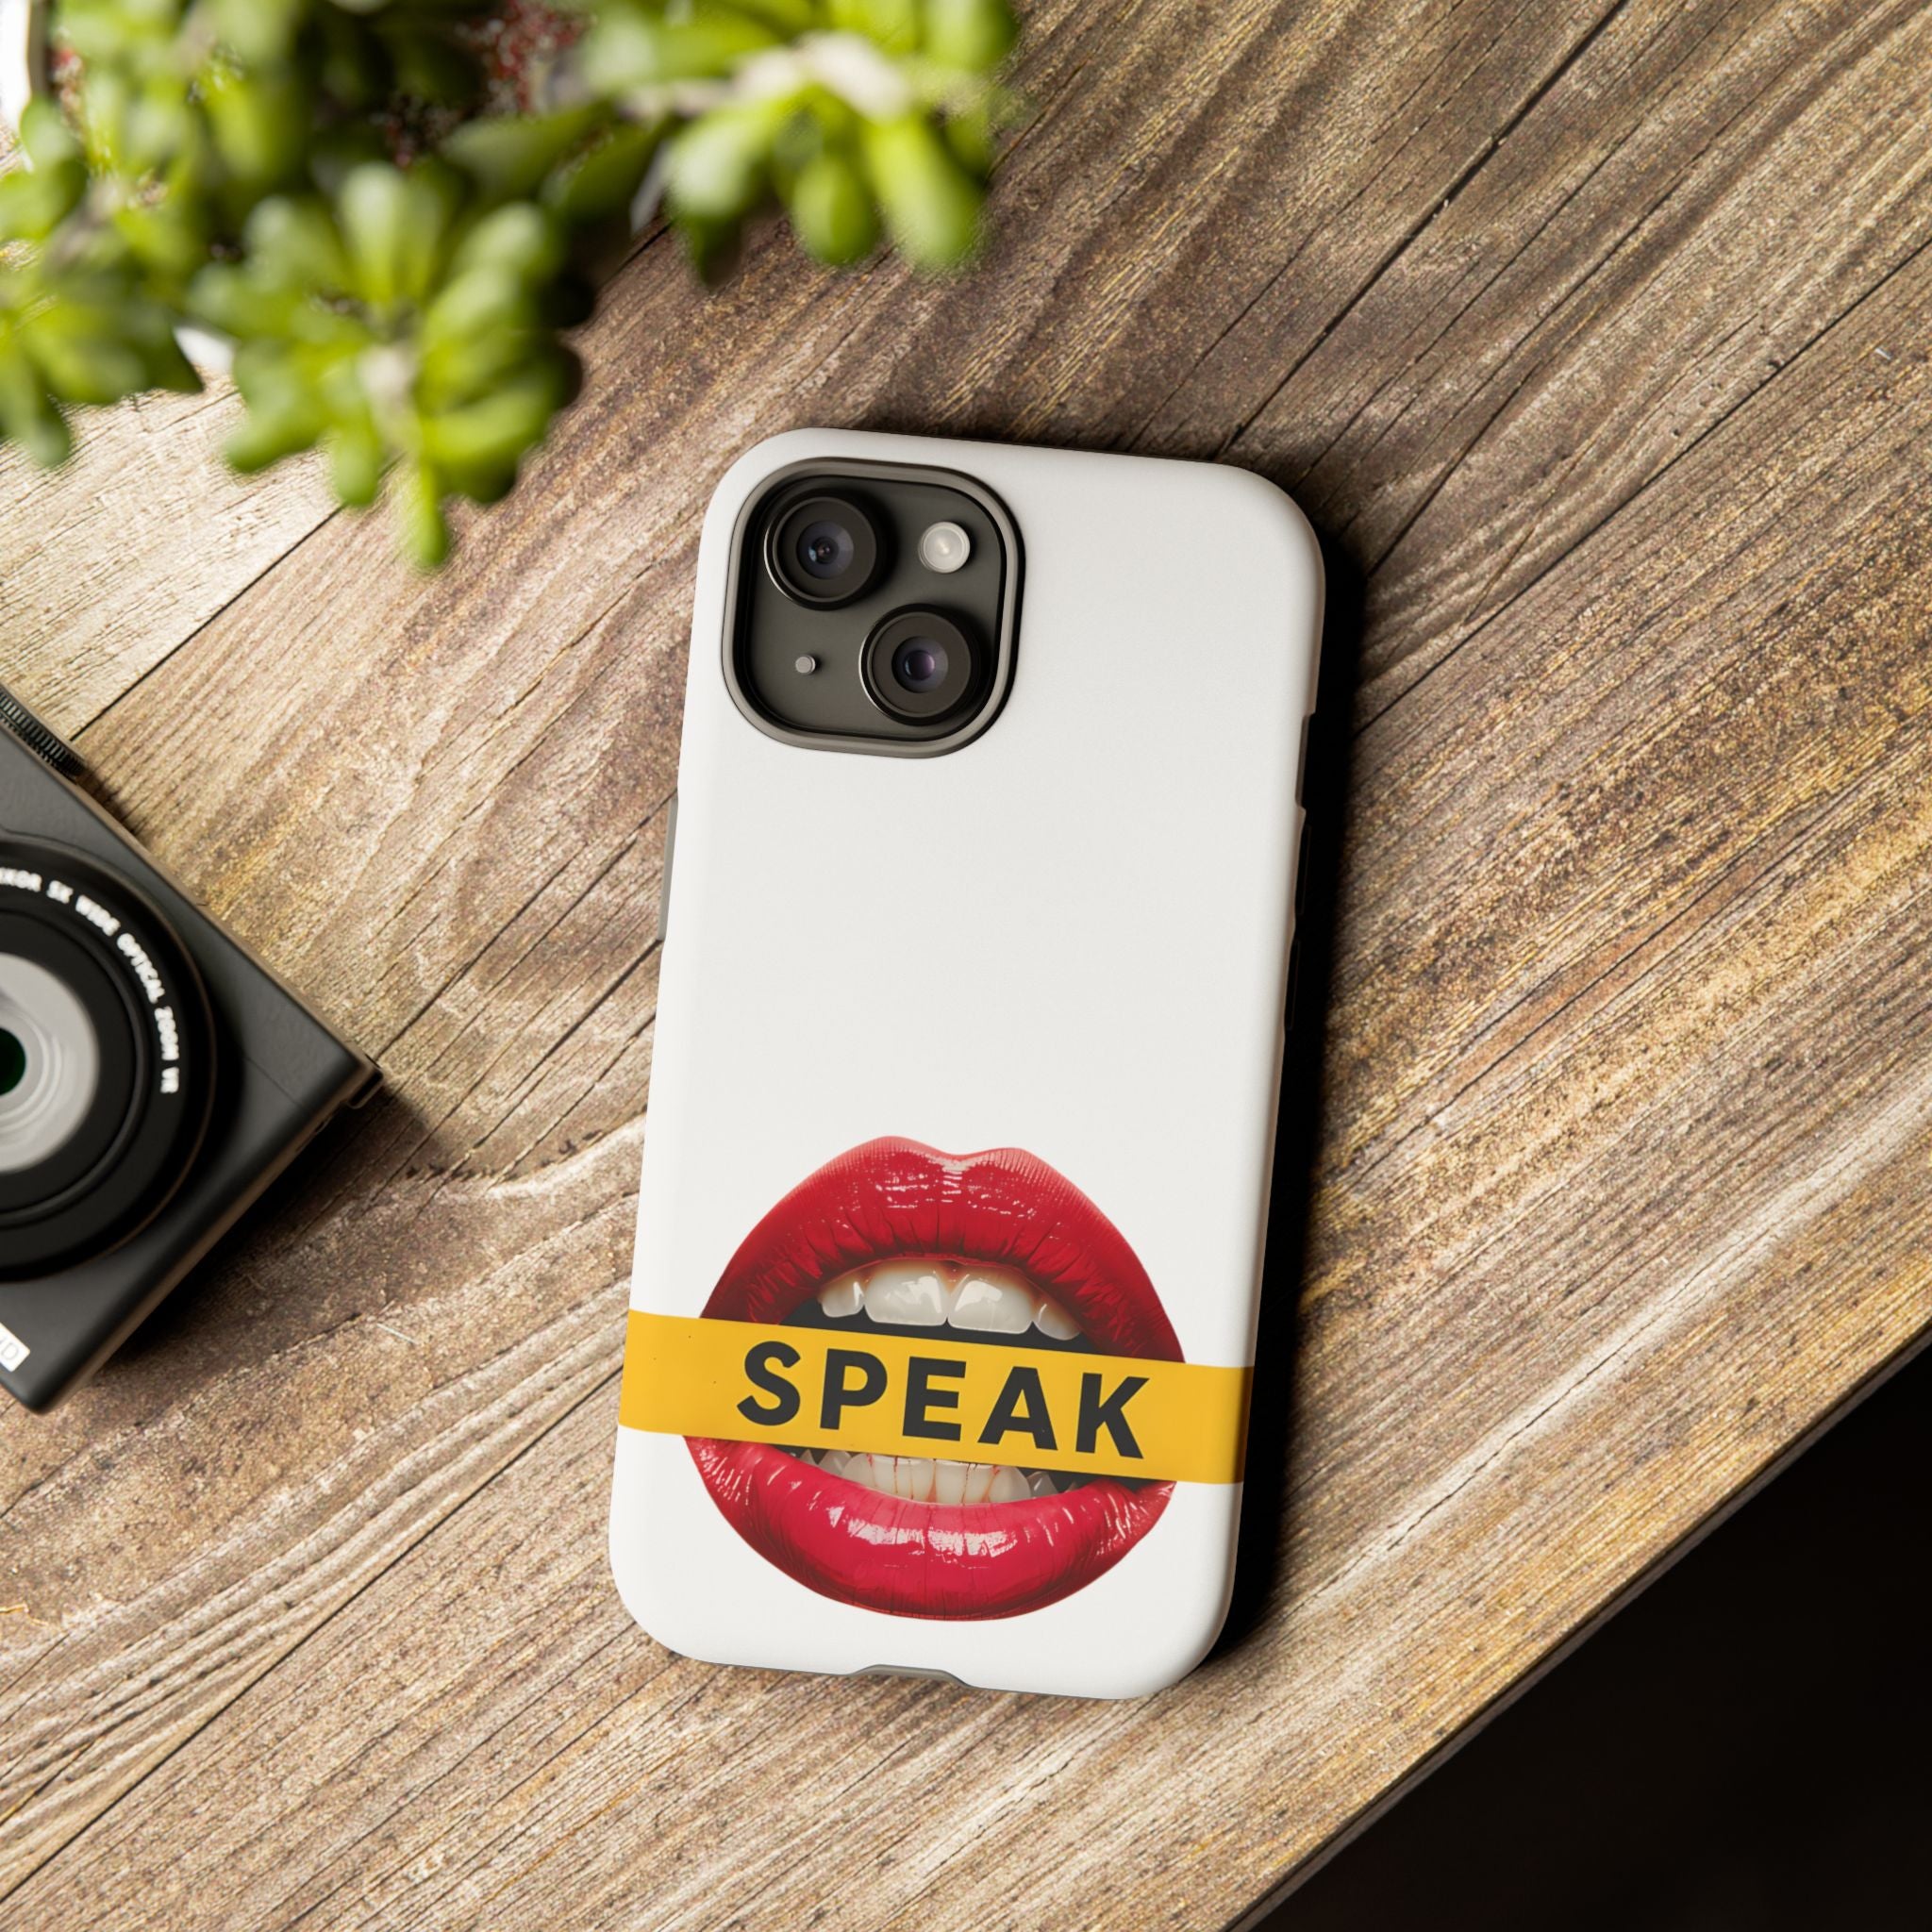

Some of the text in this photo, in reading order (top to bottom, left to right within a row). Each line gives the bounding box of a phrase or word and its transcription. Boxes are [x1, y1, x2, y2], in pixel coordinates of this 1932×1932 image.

[116, 933, 165, 1004] OPTICAL
[154, 1006, 179, 1061] ZOOM
[737, 1341, 1150, 1459] SPEAK
